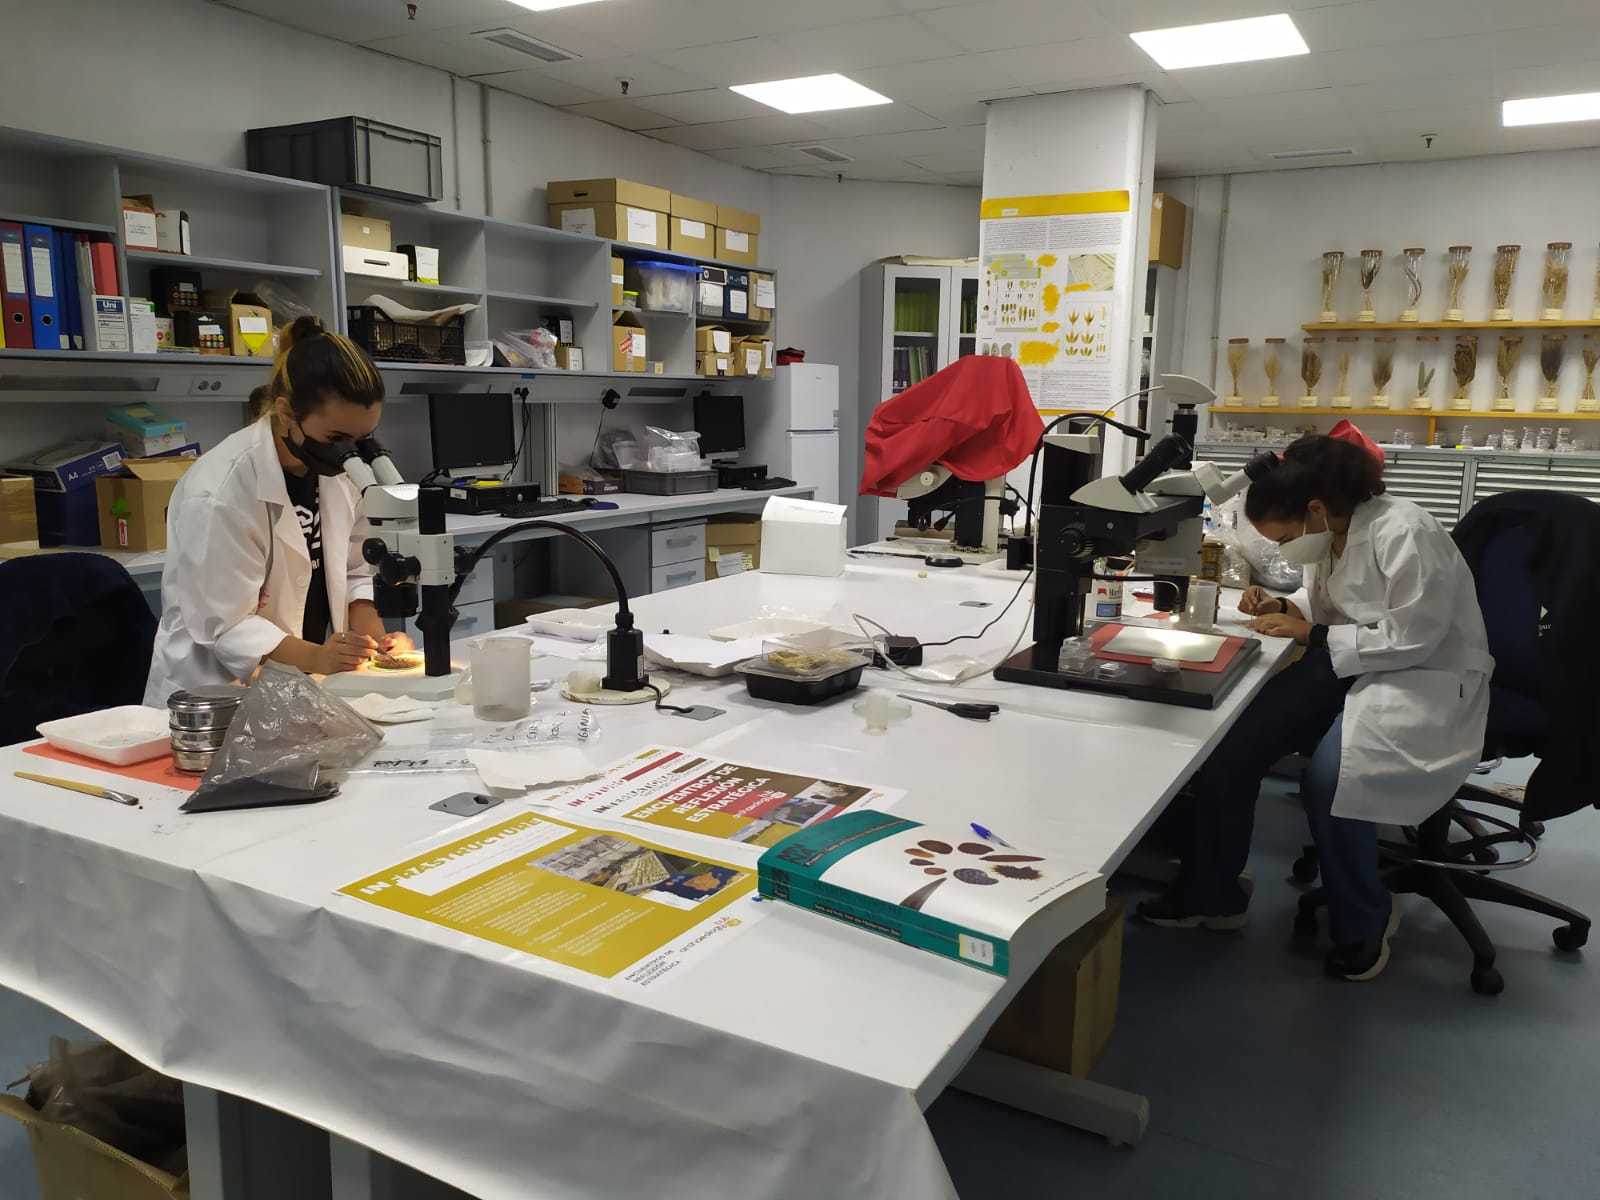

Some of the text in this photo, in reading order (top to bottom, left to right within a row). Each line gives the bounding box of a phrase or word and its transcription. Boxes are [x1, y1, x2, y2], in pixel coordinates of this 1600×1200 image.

[102, 300, 117, 309] Uni
[68, 471, 79, 481] A4
[634, 772, 718, 819] ENCUENTROS
[714, 764, 740, 777] DE
[671, 776, 744, 814] REFLEXIÓN
[685, 777, 771, 823] ESTRATÉGICA
